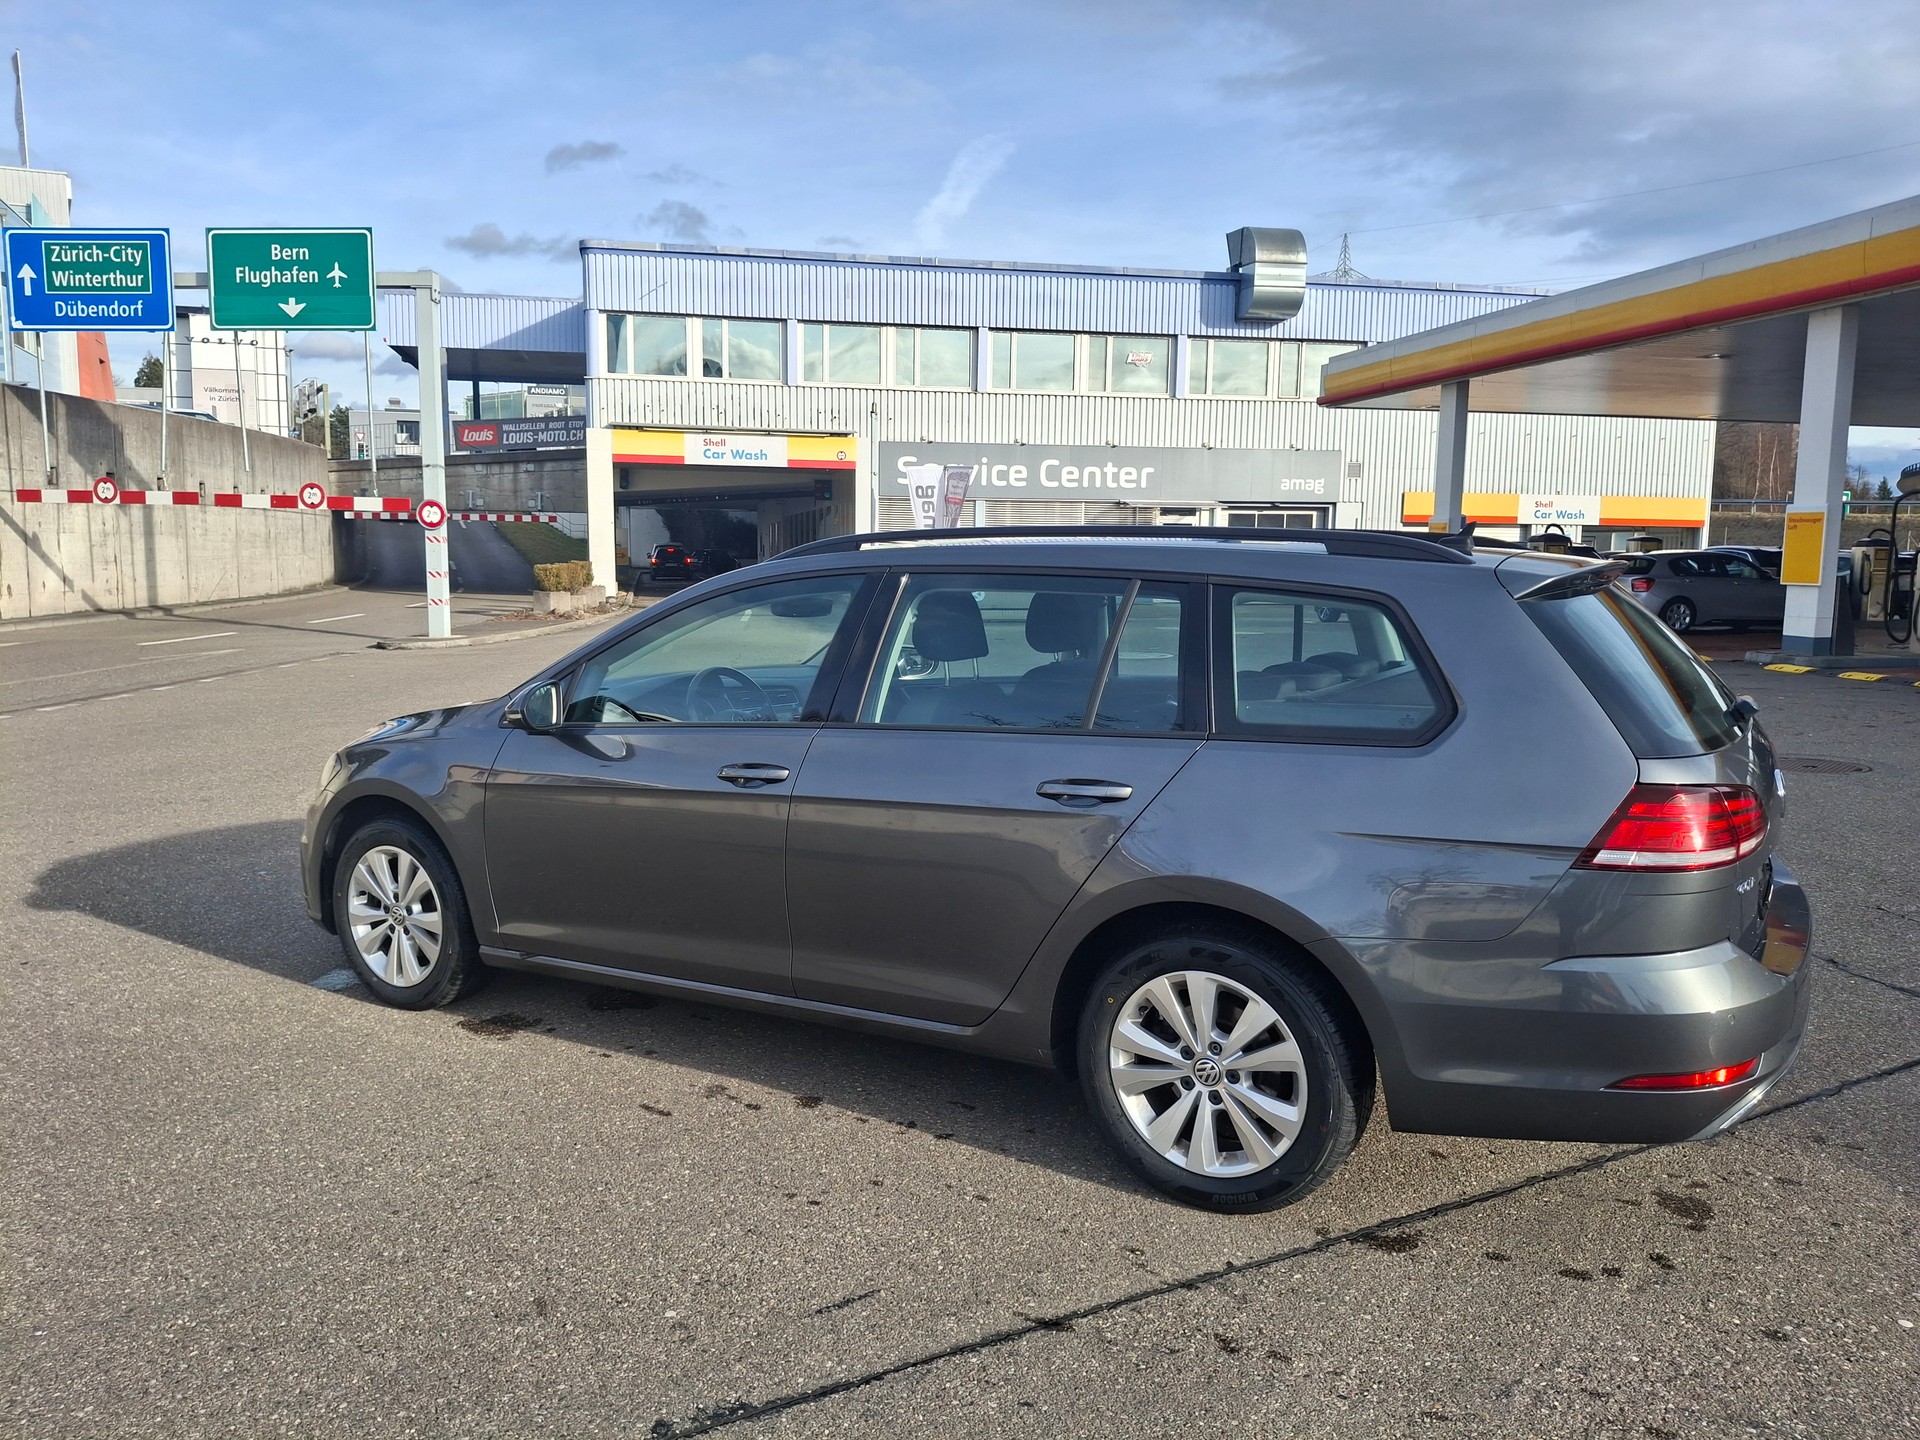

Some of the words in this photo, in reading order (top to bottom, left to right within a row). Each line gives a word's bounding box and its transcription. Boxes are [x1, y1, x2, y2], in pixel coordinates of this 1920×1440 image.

[50, 245, 142, 266] Zürich-City
[271, 244, 309, 260] Bern
[52, 270, 144, 287] Winterthur
[235, 266, 319, 287] Flughafen
[54, 300, 143, 317] Dübendorf
[185, 336, 258, 346] VOLVO
[530, 387, 566, 395] ANDIAMO
[502, 423, 545, 431] WALLISELLEN
[549, 421, 565, 429] ROOT
[569, 420, 584, 428] ETOY
[463, 428, 494, 442] Louis
[503, 429, 584, 444] LOUIS-MOTO.CH
[703, 438, 726, 447] Shell
[703, 448, 726, 459] Car
[730, 449, 768, 461] Wash
[897, 456, 1028, 487] Svice
[1040, 459, 1155, 488] Center
[1280, 477, 1325, 495] amag
[1534, 500, 1553, 508] Shell
[1534, 509, 1552, 519] Car
[1555, 509, 1585, 520] Wash
